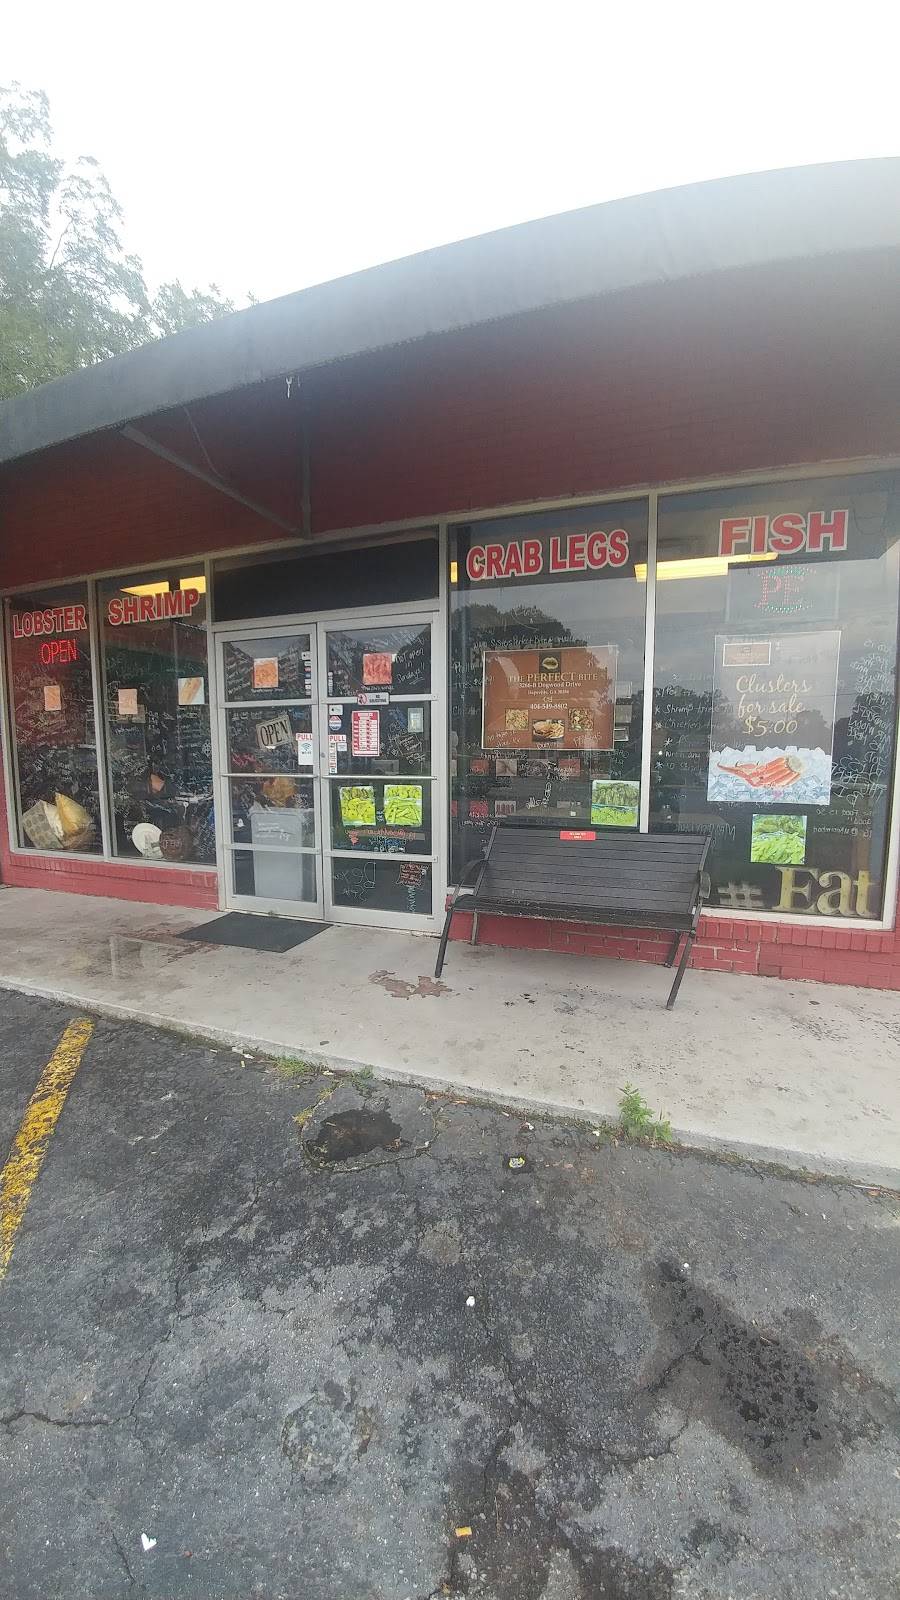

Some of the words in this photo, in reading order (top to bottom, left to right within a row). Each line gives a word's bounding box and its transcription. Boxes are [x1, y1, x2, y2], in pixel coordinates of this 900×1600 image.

[718, 509, 848, 556] FISH
[466, 539, 543, 581] CRAB
[549, 529, 629, 573] LEGS
[13, 604, 87, 639] LOBSTER
[108, 588, 200, 626] SHRIMP
[40, 638, 77, 665] OPEN
[509, 675, 525, 683] THE
[527, 671, 577, 683] PERFECT
[578, 673, 599, 682] BITE
[736, 672, 812, 694] Clusters
[738, 693, 764, 719] for
[768, 693, 806, 714] sale
[260, 719, 289, 747] OPEN
[771, 866, 878, 918] Eat
